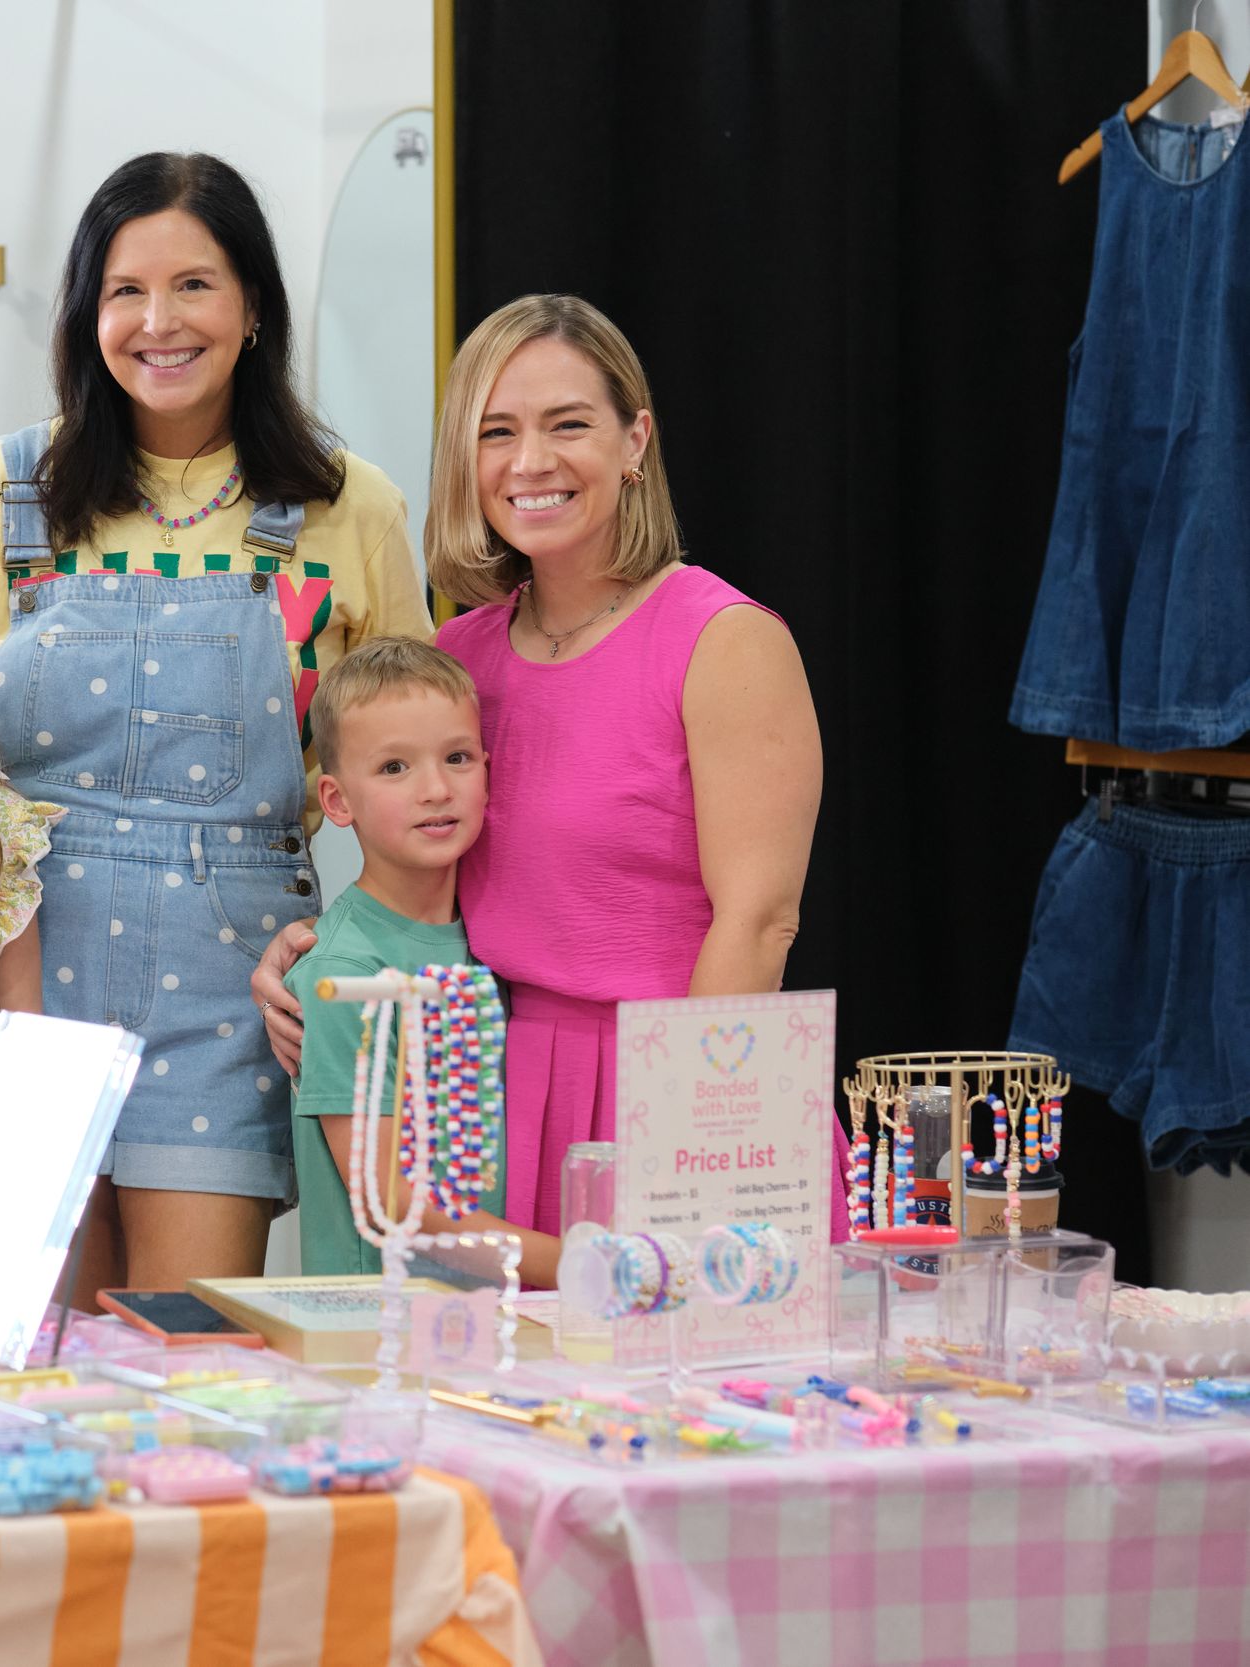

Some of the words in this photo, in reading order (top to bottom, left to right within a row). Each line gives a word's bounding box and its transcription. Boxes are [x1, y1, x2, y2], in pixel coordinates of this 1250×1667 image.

[695, 1078, 759, 1099] Banded
[692, 1103, 725, 1117] with
[729, 1099, 762, 1115] Love
[676, 1147, 730, 1174] Price
[737, 1144, 775, 1169] List
[766, 1181, 790, 1192] Charms
[768, 1204, 793, 1216] Charms
